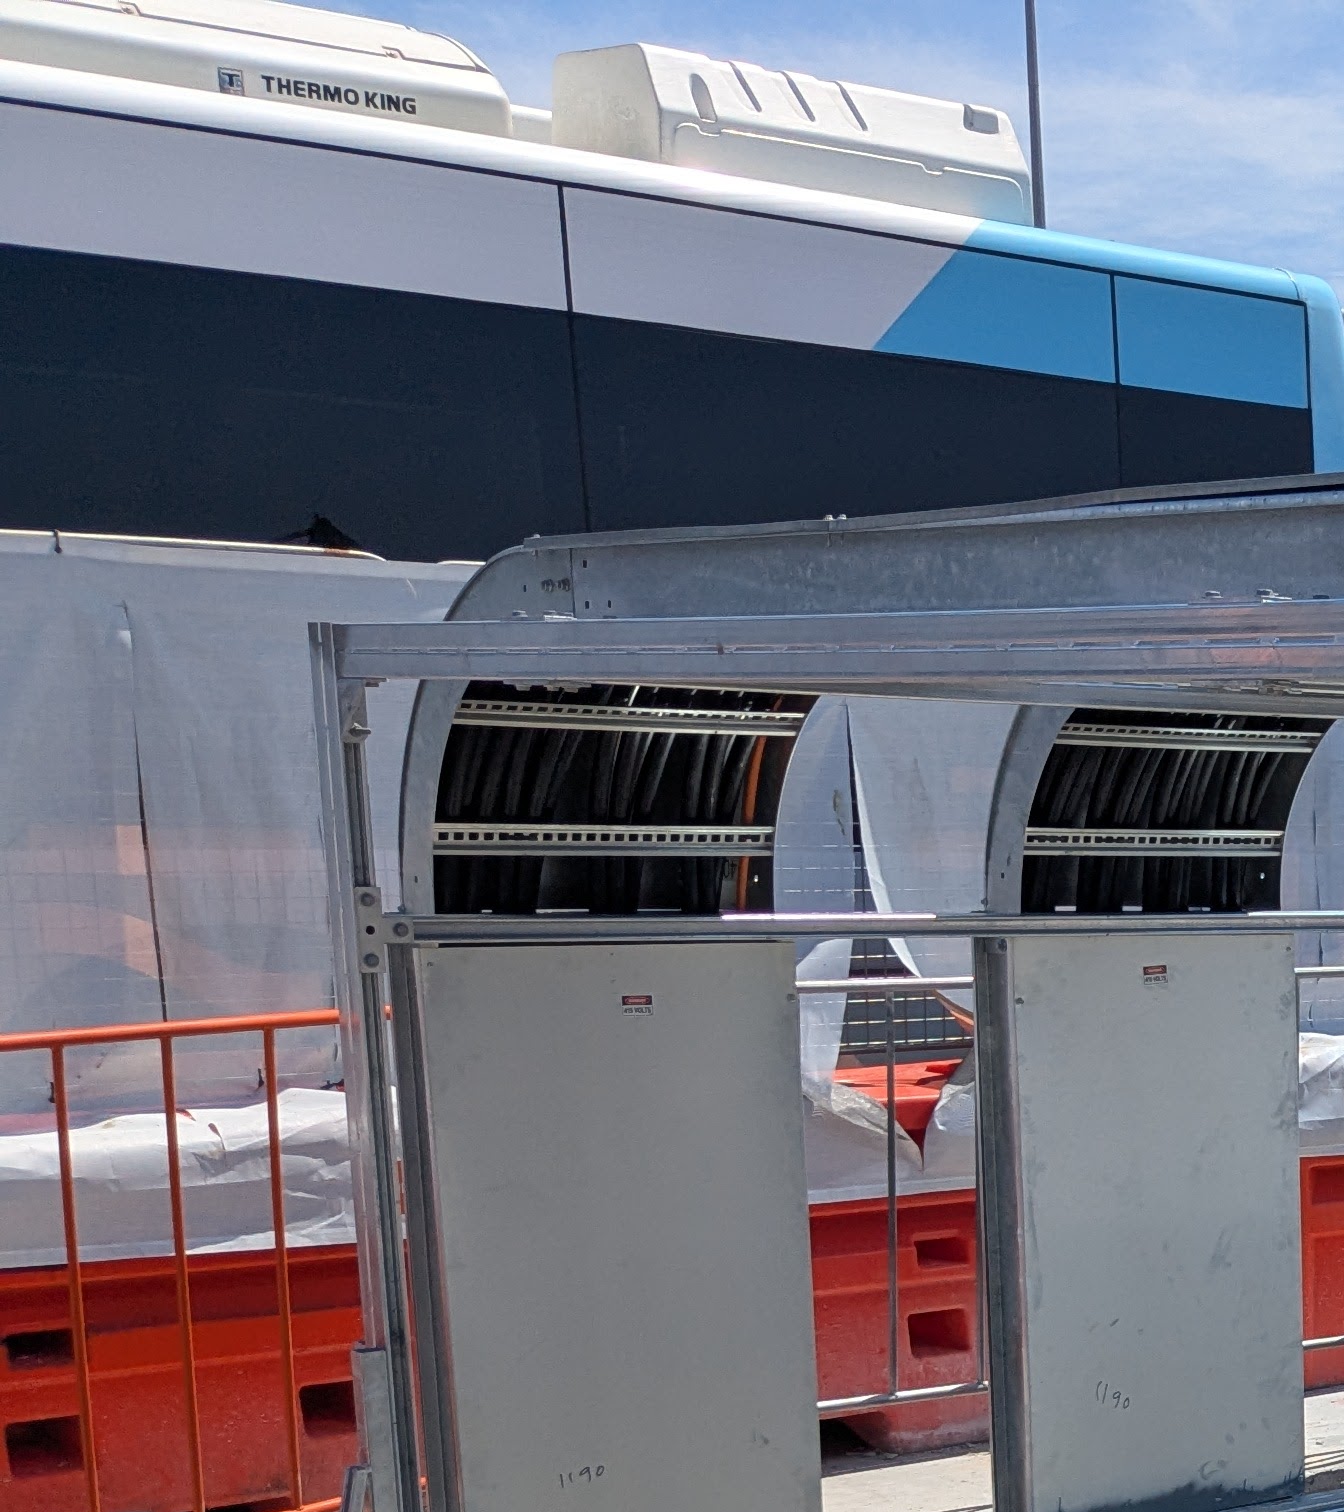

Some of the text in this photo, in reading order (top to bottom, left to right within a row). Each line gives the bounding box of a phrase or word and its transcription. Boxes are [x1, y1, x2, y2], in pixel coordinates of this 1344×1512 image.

[261, 74, 416, 115] THERMO KING
[1096, 1380, 1130, 1409] 1190
[559, 1465, 605, 1488] 1190
